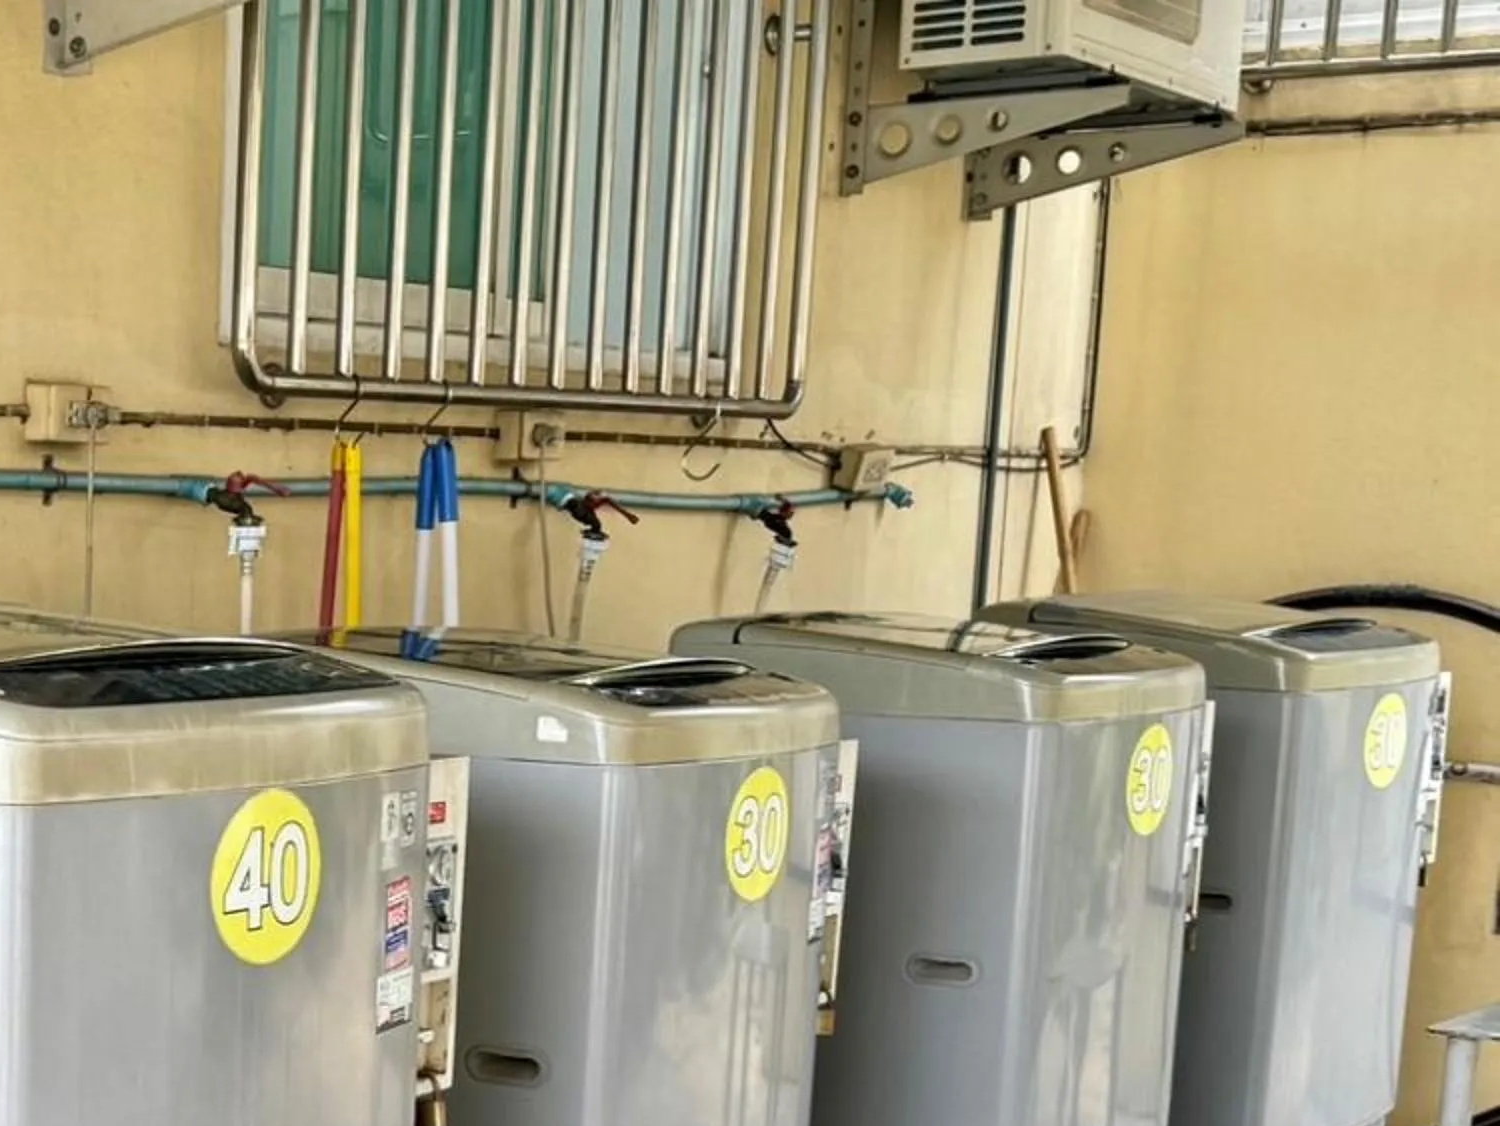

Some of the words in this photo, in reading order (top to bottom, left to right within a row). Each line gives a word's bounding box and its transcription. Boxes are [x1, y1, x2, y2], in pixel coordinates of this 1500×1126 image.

[1131, 747, 1171, 814] 30
[223, 820, 311, 932] 40
[733, 792, 784, 878] 30
